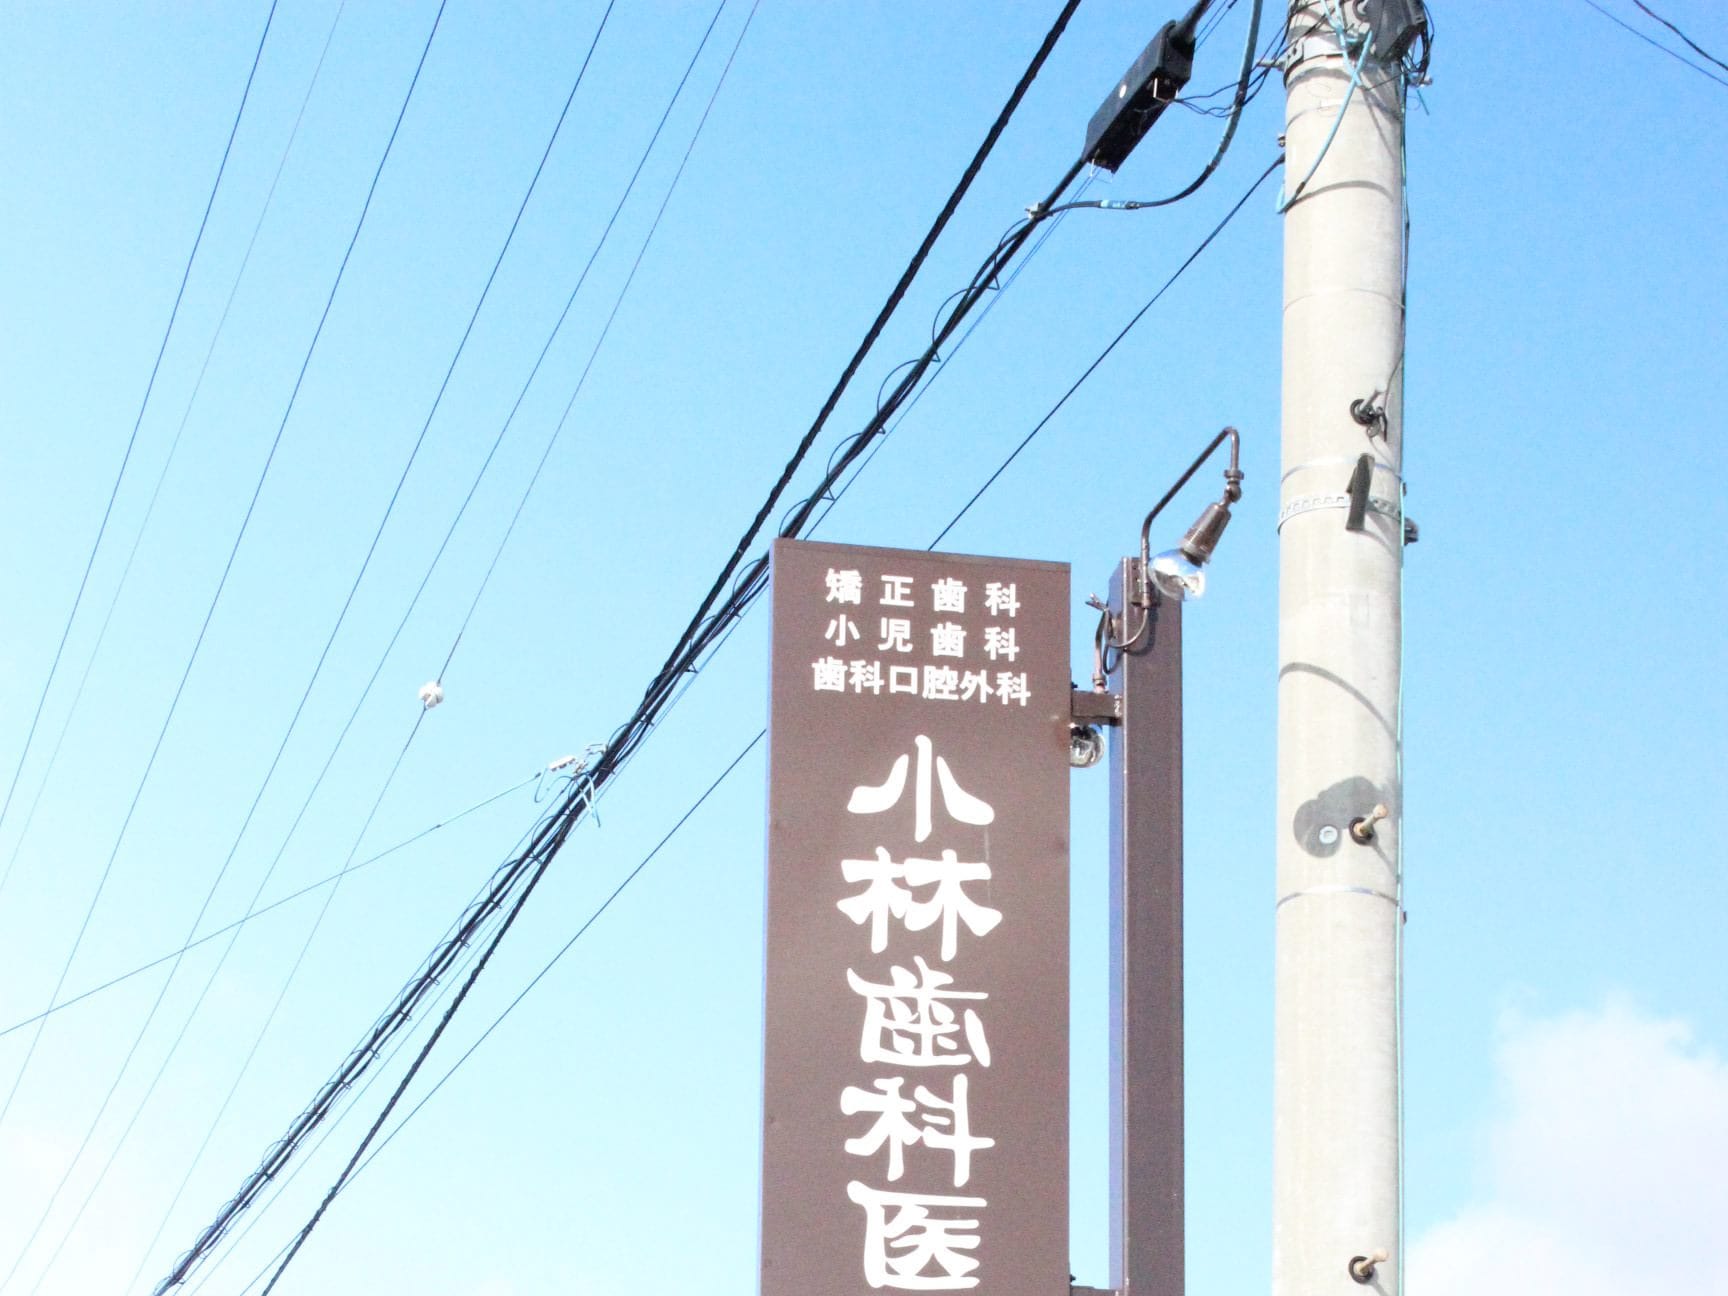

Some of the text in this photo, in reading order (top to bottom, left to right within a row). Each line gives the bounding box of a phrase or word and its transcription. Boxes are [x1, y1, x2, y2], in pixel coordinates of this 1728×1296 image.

[825, 567, 1021, 618] 矯正歯科
[824, 613, 1020, 662] 小児歯科
[811, 656, 1032, 706] 歯科口腔外科
